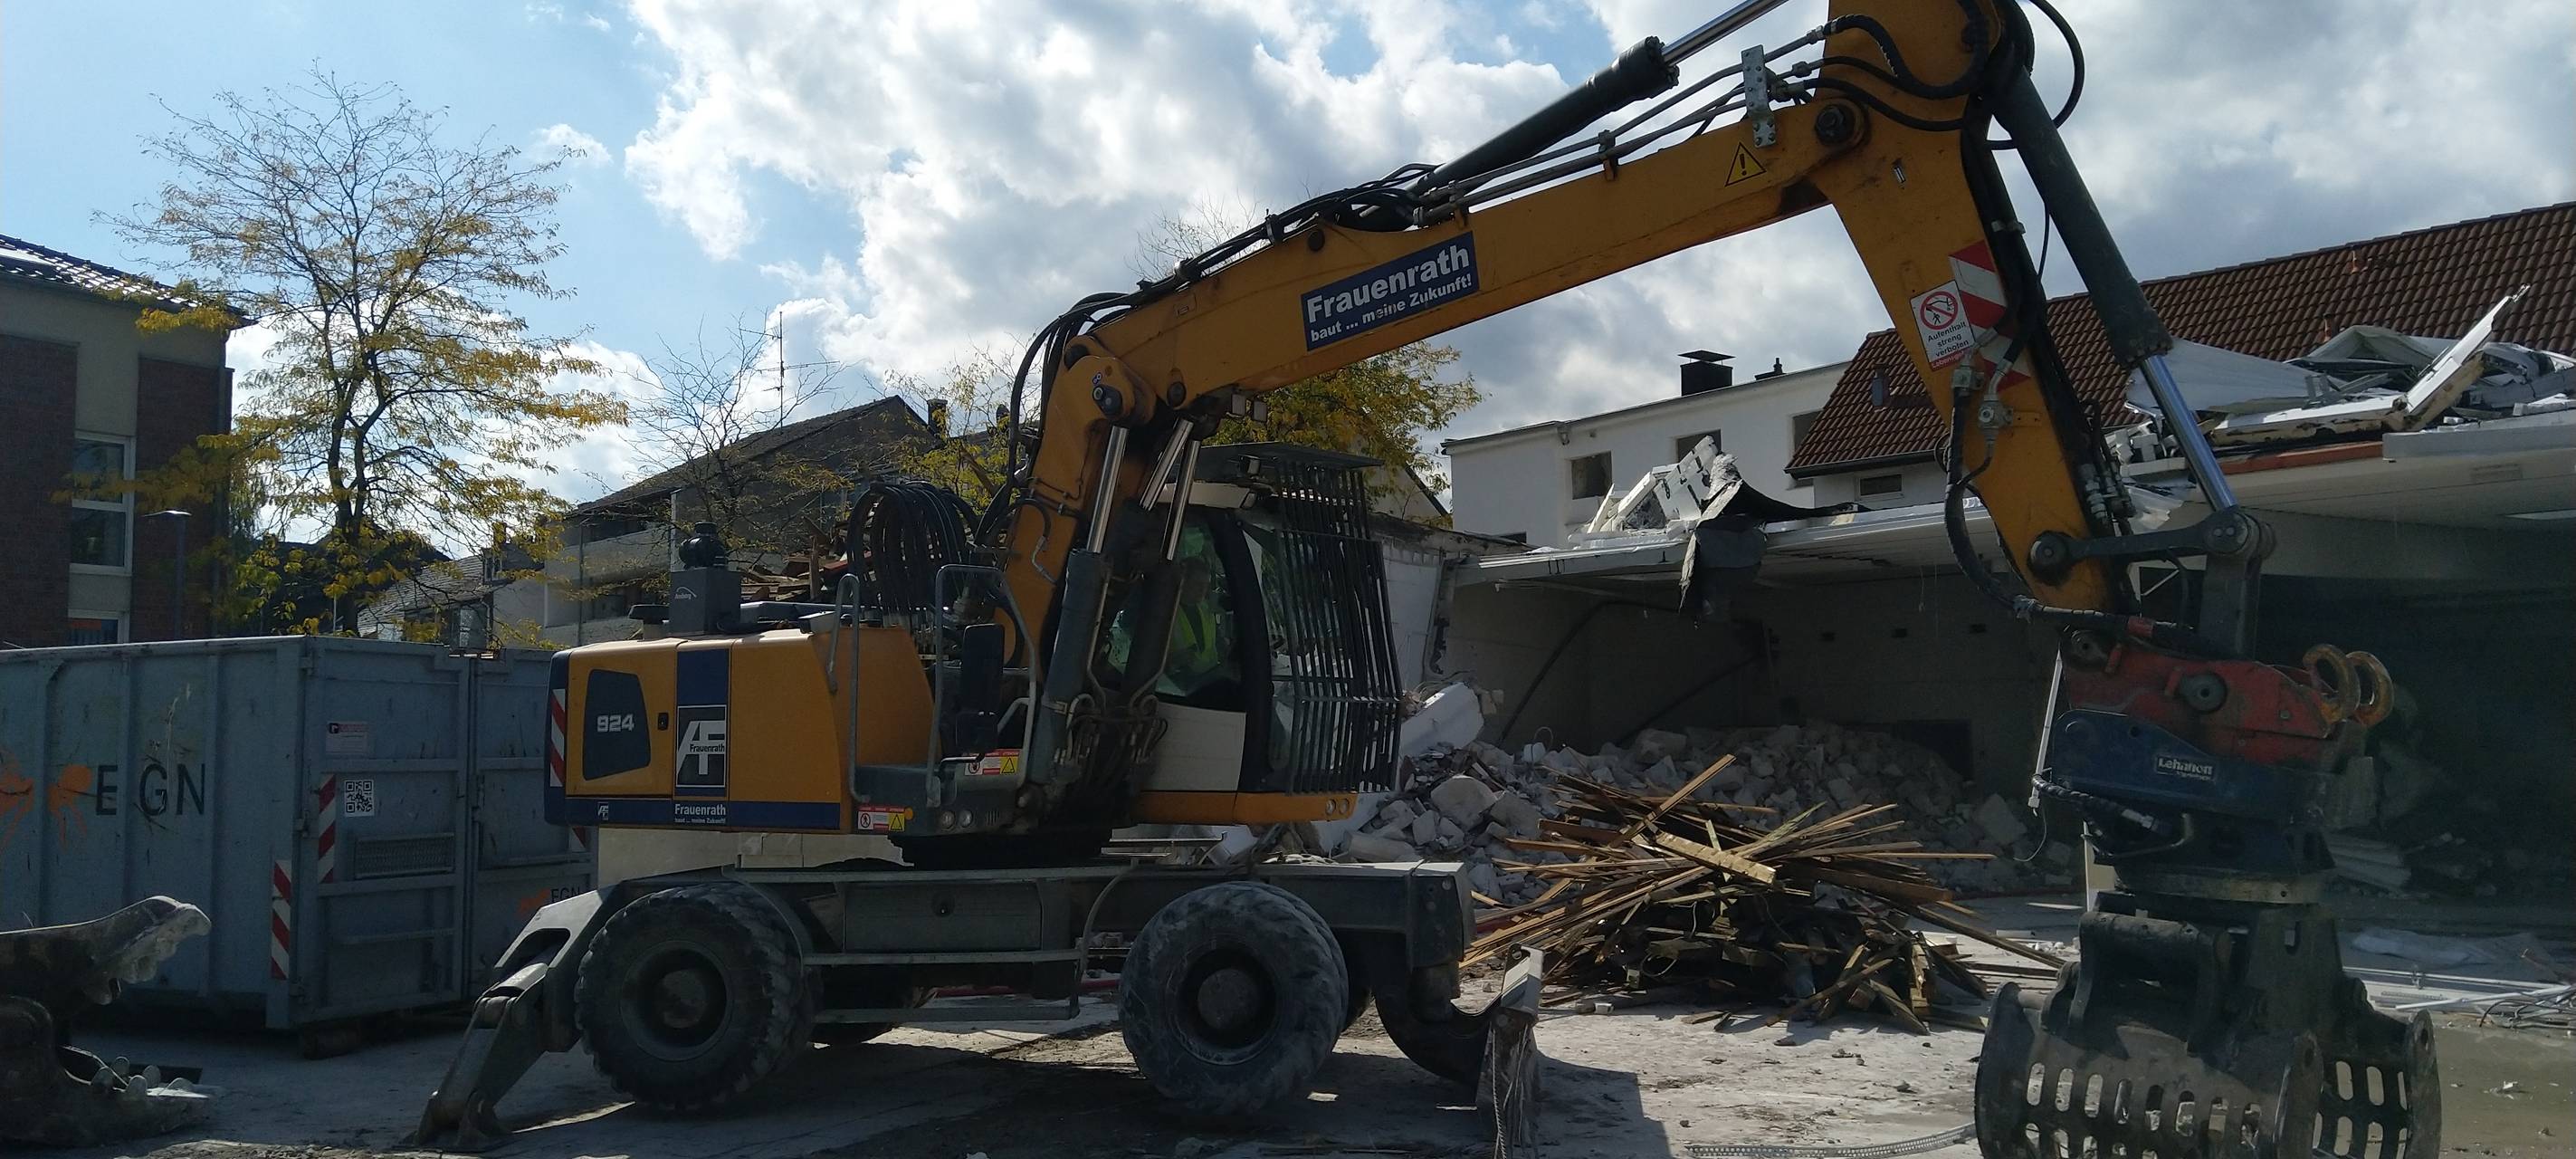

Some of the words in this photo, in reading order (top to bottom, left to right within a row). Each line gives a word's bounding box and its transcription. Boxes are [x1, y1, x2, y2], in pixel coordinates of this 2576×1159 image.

[1307, 245, 1470, 323] Frauenrath
[1311, 321, 1342, 342] baut
[1362, 302, 1406, 324] meine
[1409, 273, 1473, 308] Zukunft!
[1928, 321, 1966, 342] Aufenthalt
[1937, 333, 1962, 348] streng
[1935, 340, 1970, 357] verboten
[597, 714, 634, 733] 924
[690, 743, 725, 752] Frauenrath
[674, 803, 726, 816] Frauenrath
